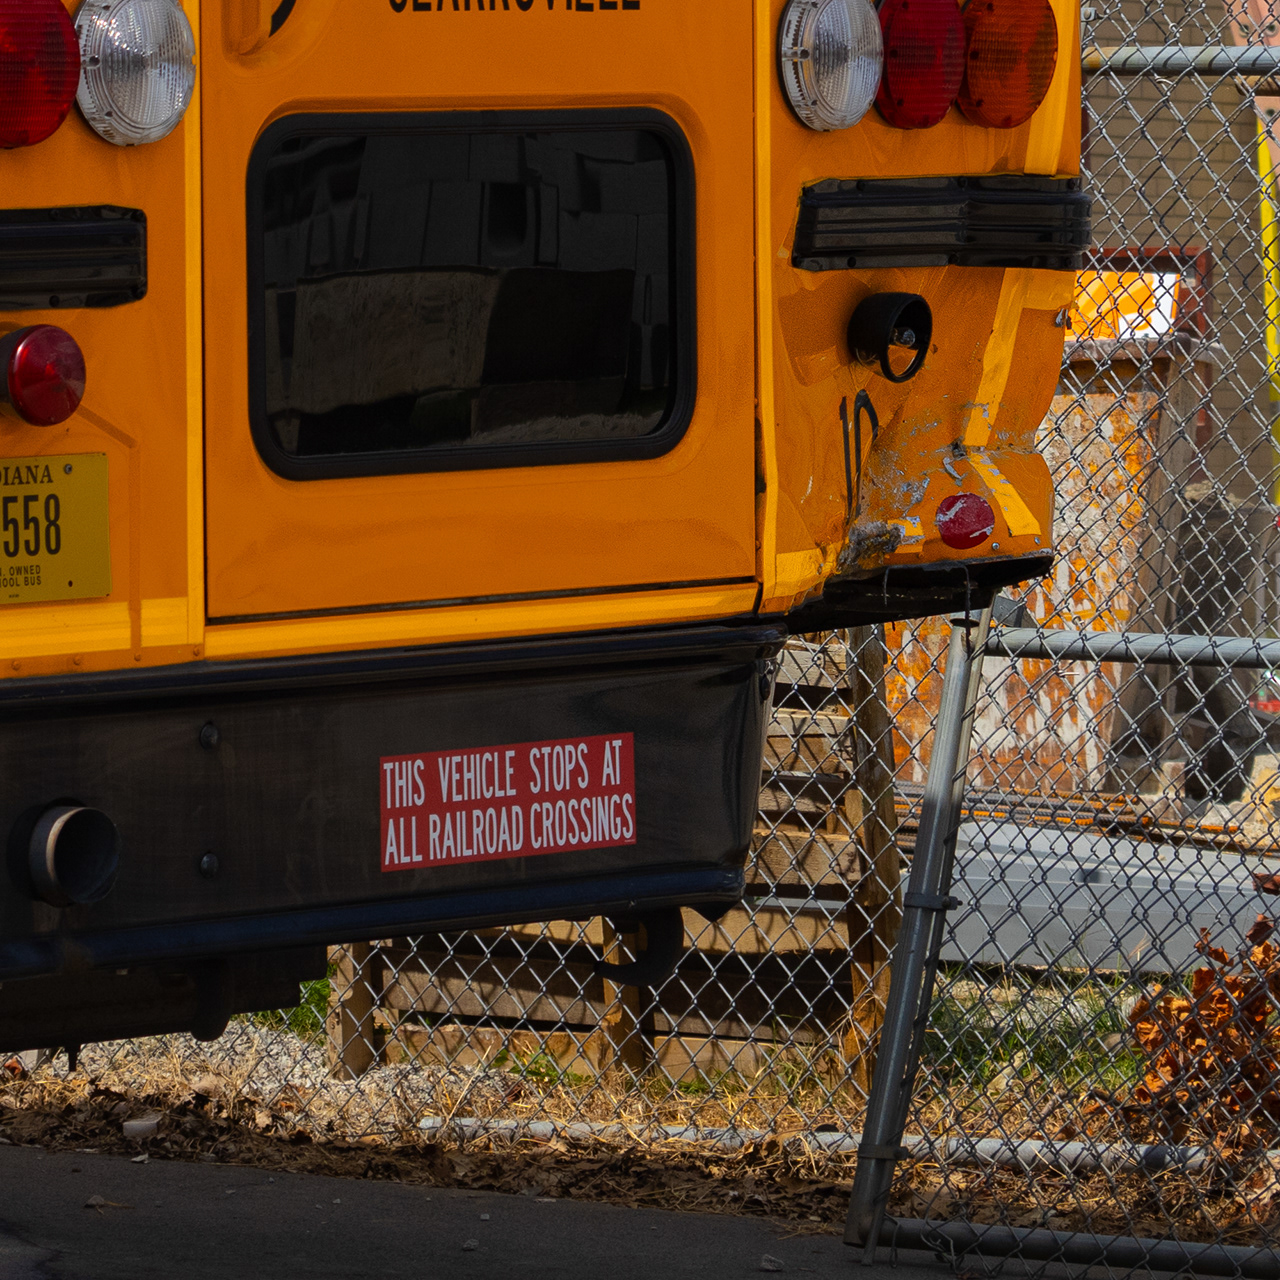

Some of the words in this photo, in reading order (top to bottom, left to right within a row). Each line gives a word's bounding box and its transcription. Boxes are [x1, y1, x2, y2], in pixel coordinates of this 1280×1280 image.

[8, 565, 41, 577] OWNED
[23, 575, 42, 587] BUS
[383, 758, 426, 809] THIS
[437, 750, 517, 803] VEHICLE
[529, 742, 589, 794] STOPS
[601, 739, 623, 787] AT
[384, 816, 423, 866] ALL
[428, 805, 524, 860] RAILROAD
[530, 792, 634, 849] CROSSINGS
